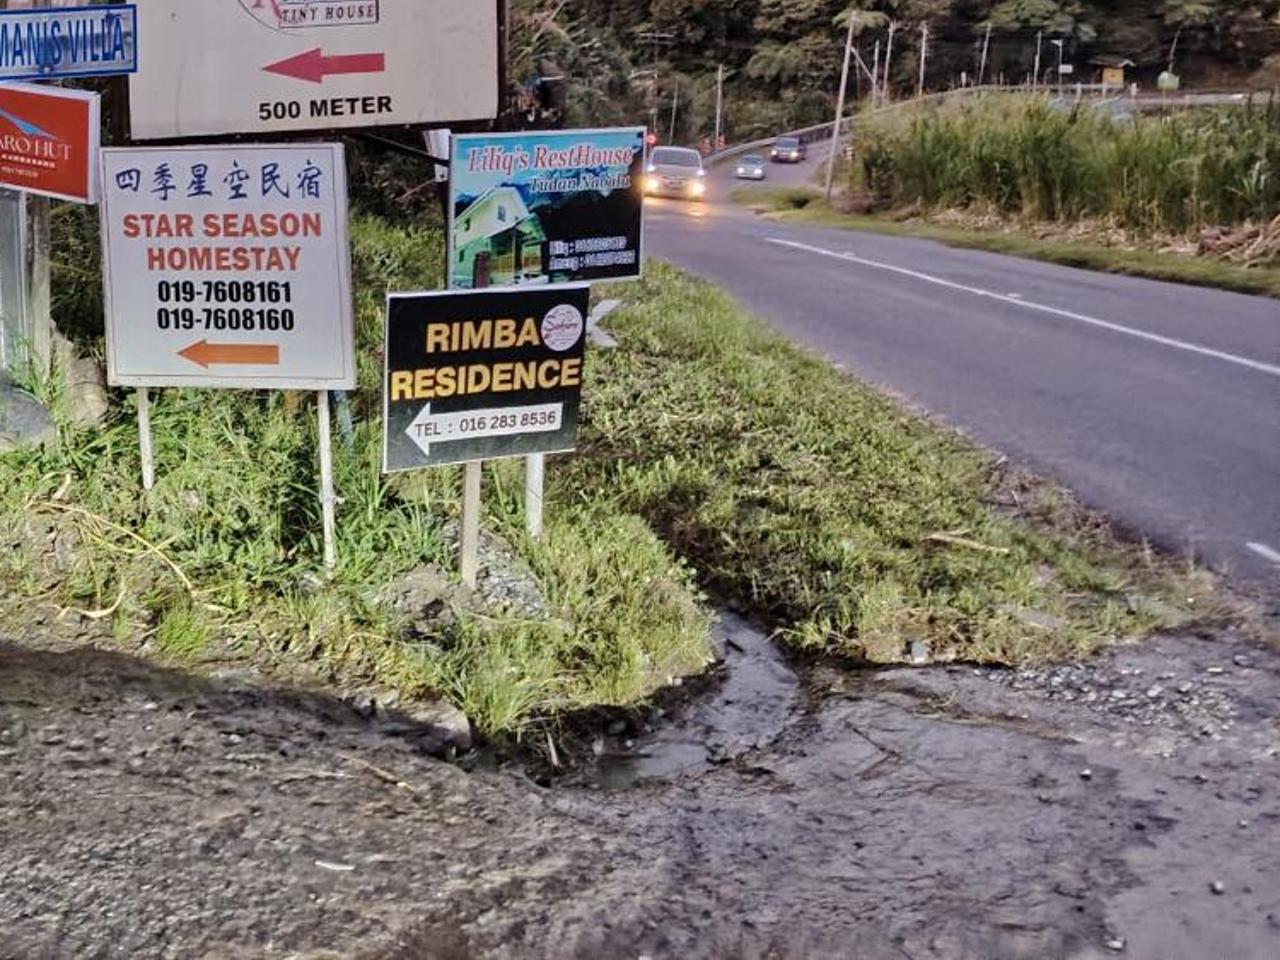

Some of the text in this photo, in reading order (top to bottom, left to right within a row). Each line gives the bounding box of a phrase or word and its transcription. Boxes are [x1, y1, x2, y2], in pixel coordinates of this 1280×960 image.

[282, 5, 375, 23] TINY HOUSE
[68, 14, 126, 64] VILLA
[259, 95, 393, 120] 500 METER
[34, 140, 73, 161] HUT
[534, 141, 634, 169] RestHouse
[115, 159, 322, 201] 四季星空民宿
[123, 212, 322, 238] STAR SEASON
[147, 246, 301, 271] HOMESTAY
[158, 280, 292, 303] 019-7608161
[156, 308, 295, 331] 019-7608160
[426, 317, 541, 354] RIMBA
[390, 357, 582, 401] RESIDENCE
[415, 422, 441, 437] TEL
[460, 416, 486, 432] 016
[489, 414, 517, 430] 283
[520, 411, 557, 427] 8536
